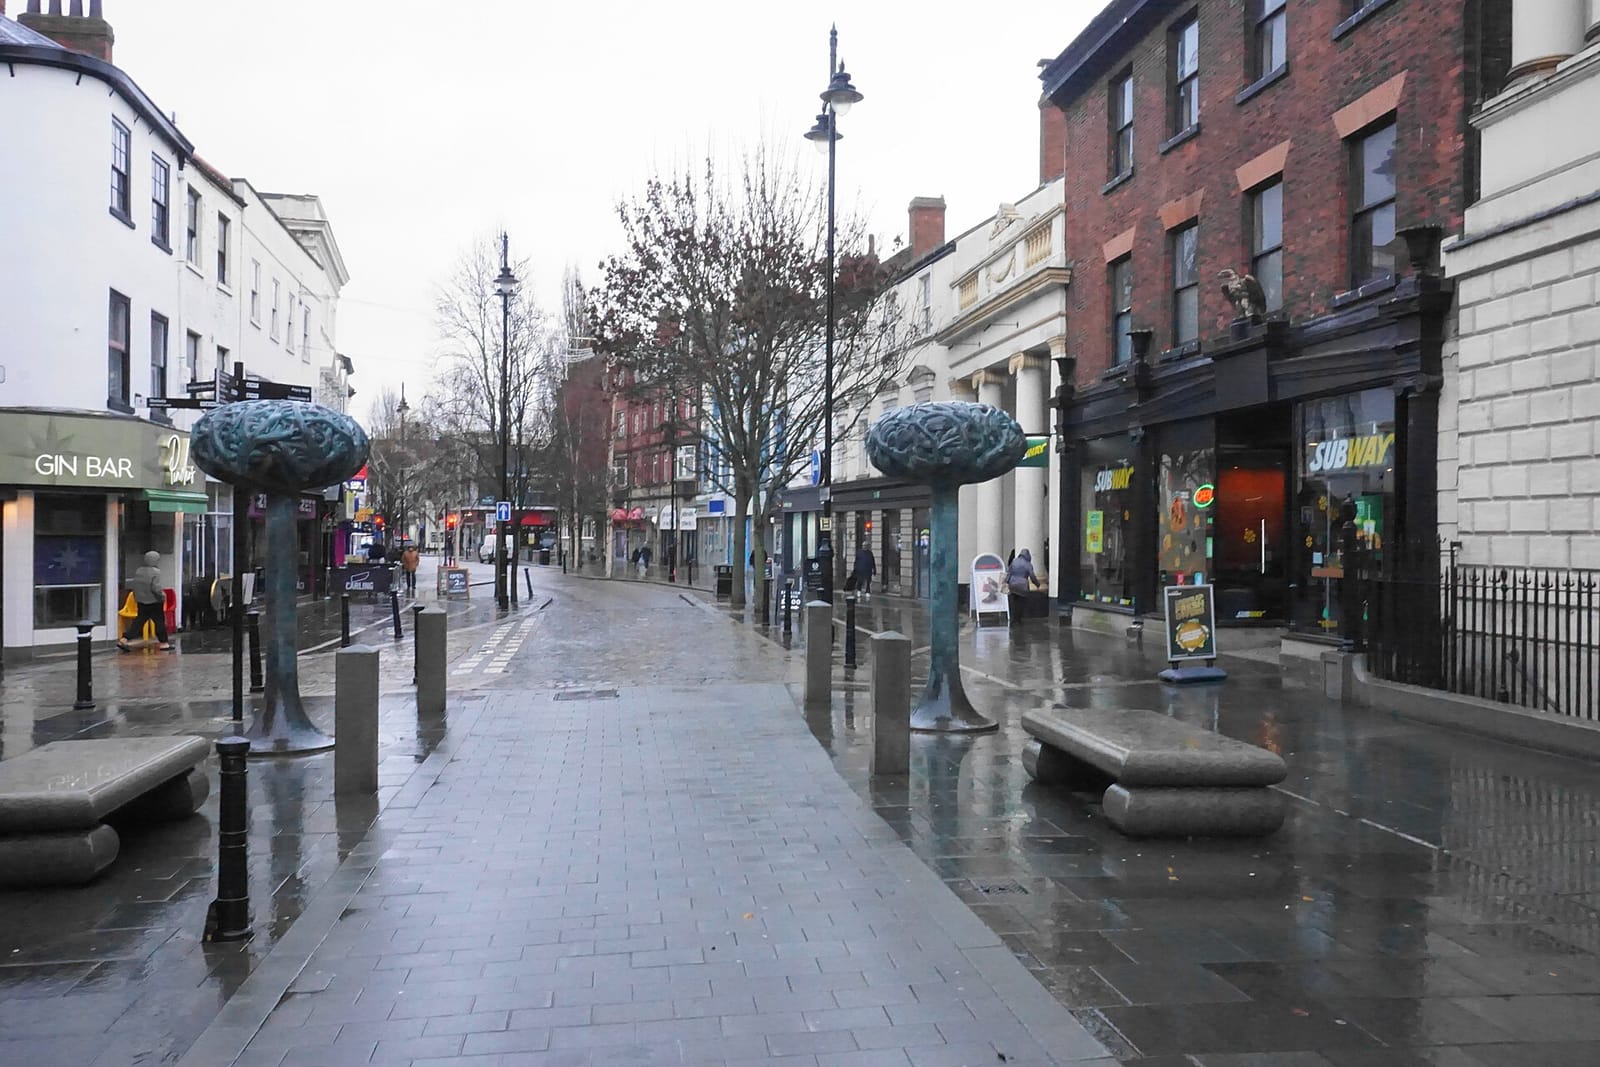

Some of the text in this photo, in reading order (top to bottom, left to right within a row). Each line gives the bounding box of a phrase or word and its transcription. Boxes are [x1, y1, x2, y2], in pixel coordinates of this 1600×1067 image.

[1310, 433, 1395, 472] SUBWAY
[35, 454, 134, 479] GIN BAR
[1095, 466, 1134, 492] SUBWAY
